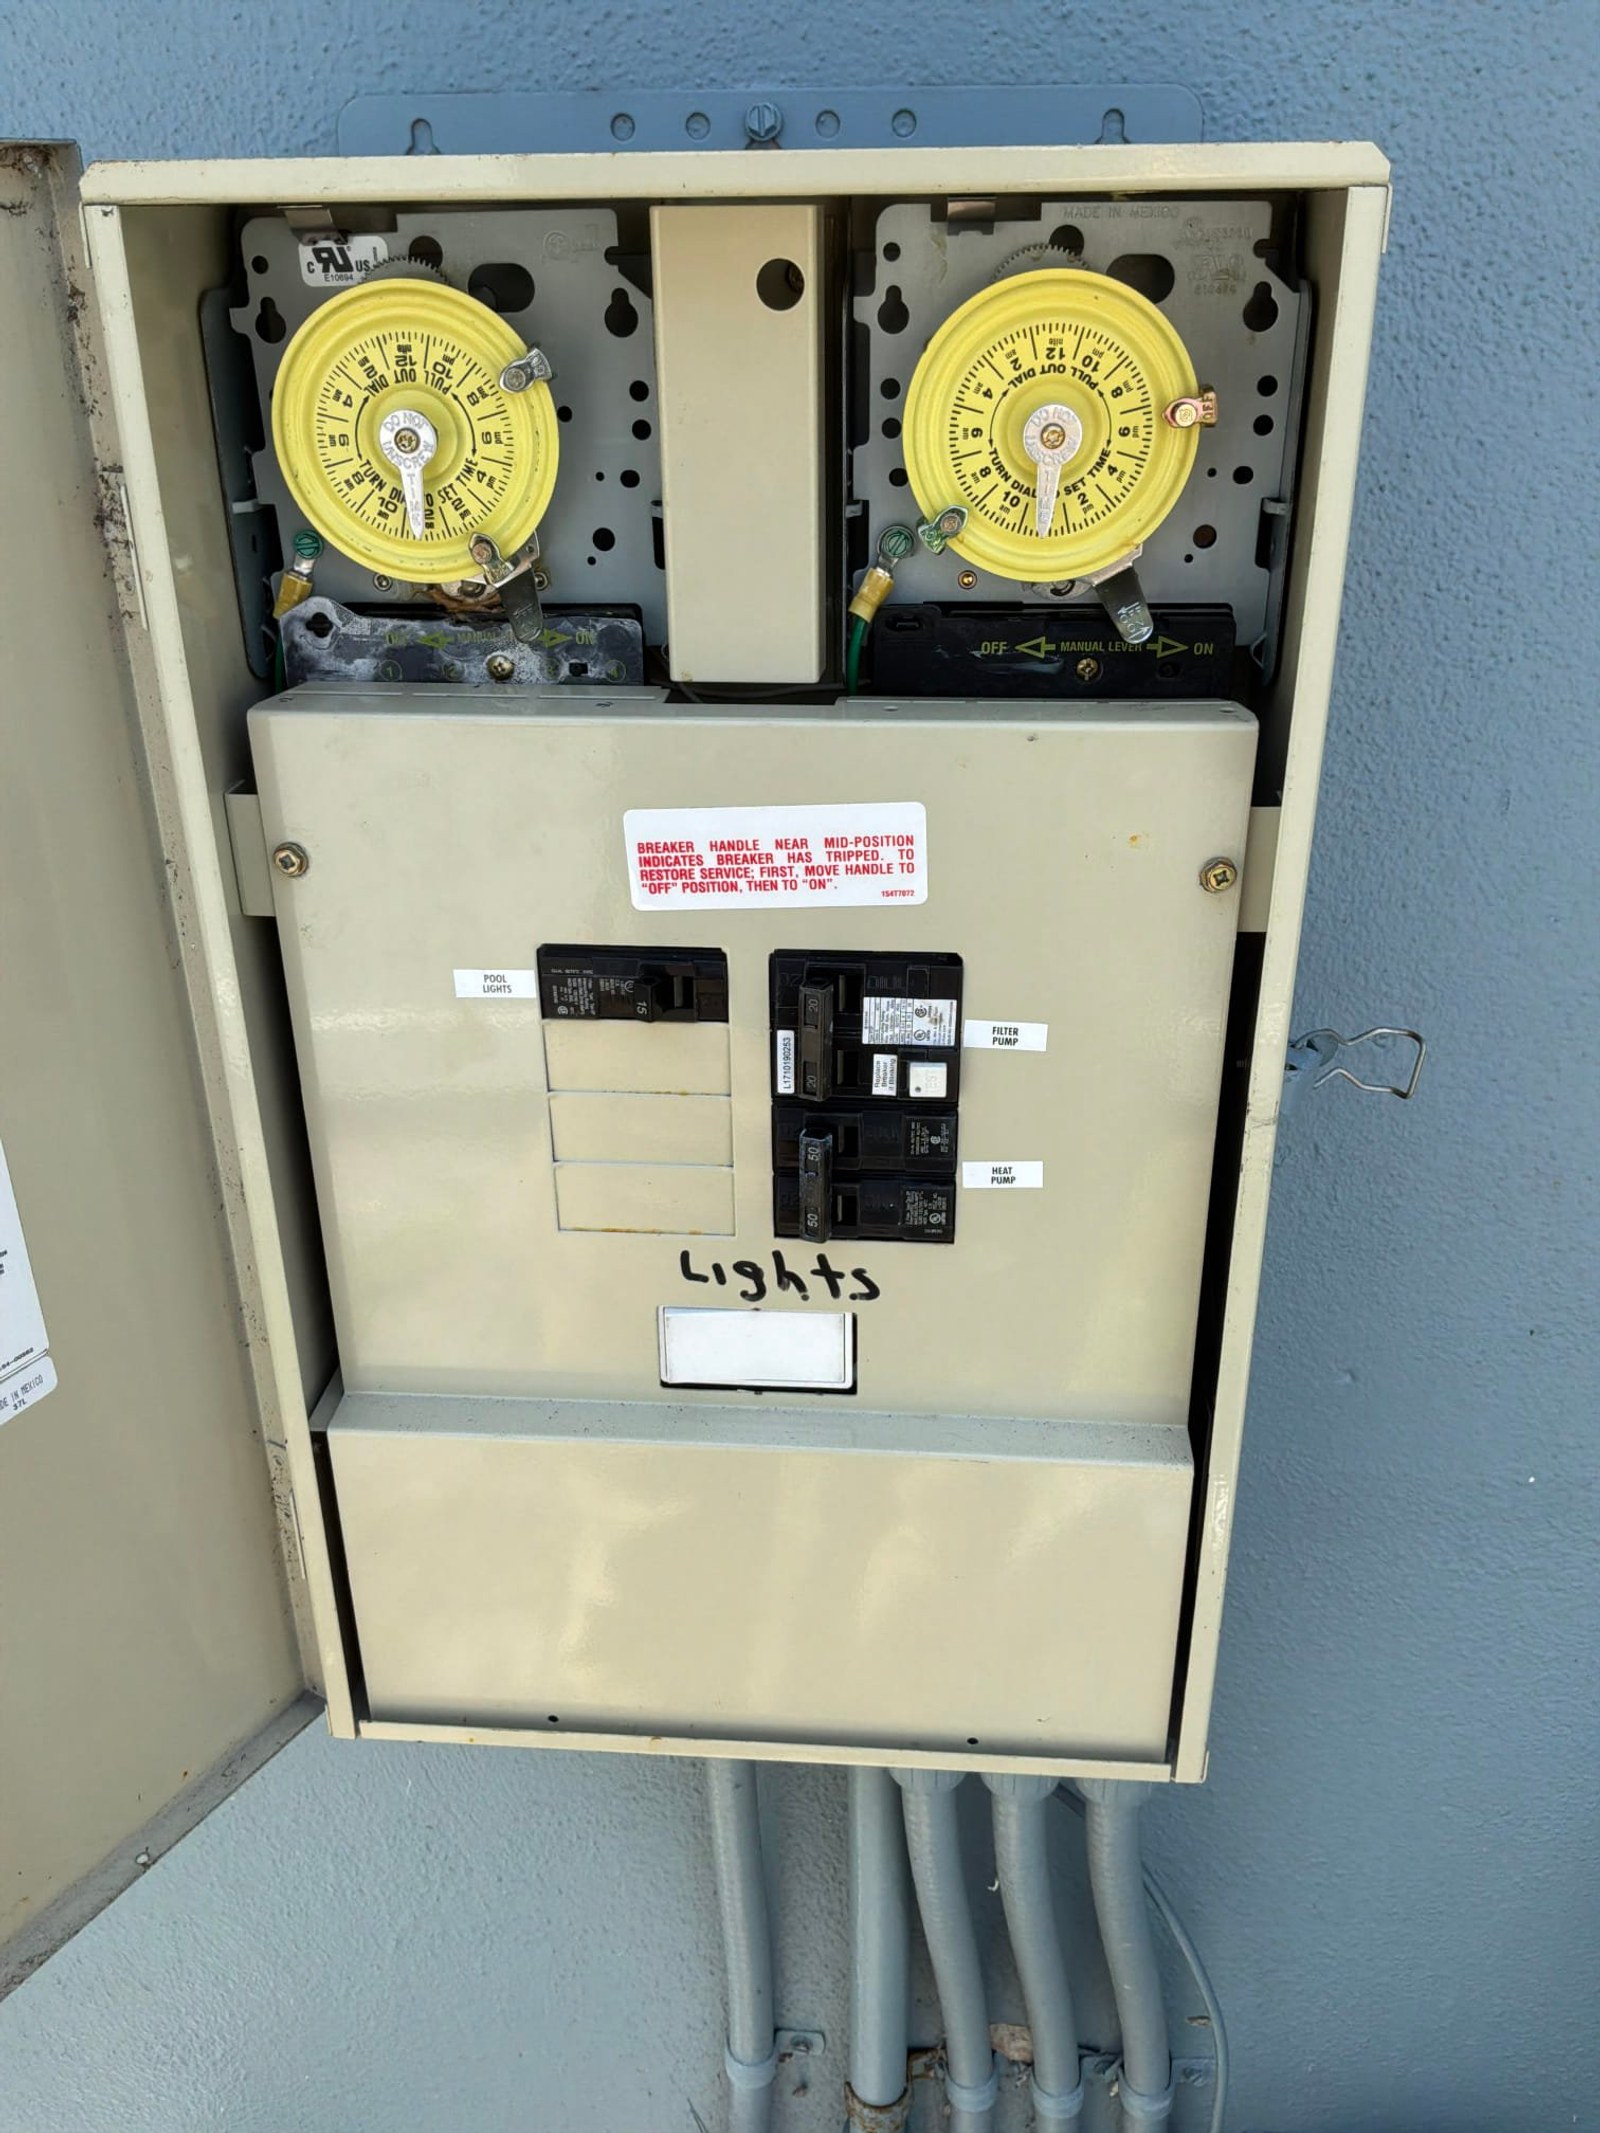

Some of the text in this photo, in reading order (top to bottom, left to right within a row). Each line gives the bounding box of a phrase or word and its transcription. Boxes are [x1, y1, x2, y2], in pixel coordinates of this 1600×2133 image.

[394, 354, 417, 367] 12
[1045, 347, 1066, 360] 12
[432, 361, 453, 379] 10
[1010, 357, 1022, 371] 2
[1082, 354, 1100, 373] 10
[363, 364, 378, 380] 2
[1008, 363, 1099, 391] PULL OUT DIAL
[363, 367, 452, 397] PULL OUT DIAL
[466, 391, 480, 407] 8
[982, 387, 993, 400] 4
[1110, 386, 1124, 399] 8
[342, 394, 353, 408] 4
[481, 431, 492, 445] 6
[970, 427, 983, 438] 6
[1118, 426, 1131, 437] 6
[338, 433, 350, 447] 6
[476, 470, 487, 483] 4
[979, 465, 992, 478] 8
[988, 447, 1112, 498] TURN DIAL SET TIME
[1107, 464, 1119, 476] 4
[351, 470, 365, 486] 8
[359, 458, 387, 492] TURN
[437, 482, 458, 504] SET
[455, 457, 478, 487] TIME
[377, 495, 398, 514] 10
[451, 497, 466, 511] 2
[1002, 490, 1021, 508] 10
[1077, 492, 1089, 506] 2
[980, 641, 1008, 655] OFF
[1059, 640, 1143, 653] MANUAL LEVER
[1193, 642, 1214, 656] ON
[637, 834, 914, 854] BREAKER HANDLE NEAR MID-POSITION
[638, 848, 915, 868] INDICATES BREAKER HAS TRIPPED. TO
[640, 868, 695, 882] RESTORE
[699, 866, 755, 880] SERVICE;
[804, 864, 840, 877] MOVE
[845, 863, 894, 875] HANDLE
[899, 862, 915, 874] TO
[641, 881, 678, 895] “OFF”
[681, 880, 743, 894] POSITION,
[746, 879, 779, 892] THEN
[781, 878, 798, 891] TO
[483, 973, 507, 984] POOL
[482, 984, 512, 994] LIGHTS
[636, 1001, 648, 1016] 15
[808, 999, 820, 1013] 20
[992, 1026, 1019, 1037] FILTER
[992, 1037, 1018, 1047] PUMP
[805, 1075, 817, 1089] 20
[807, 1146, 820, 1161] 50
[991, 1166, 1013, 1175] HEAT
[990, 1175, 1016, 1185] PUMP
[807, 1213, 819, 1228] 50
[680, 1250, 881, 1302] Lights
